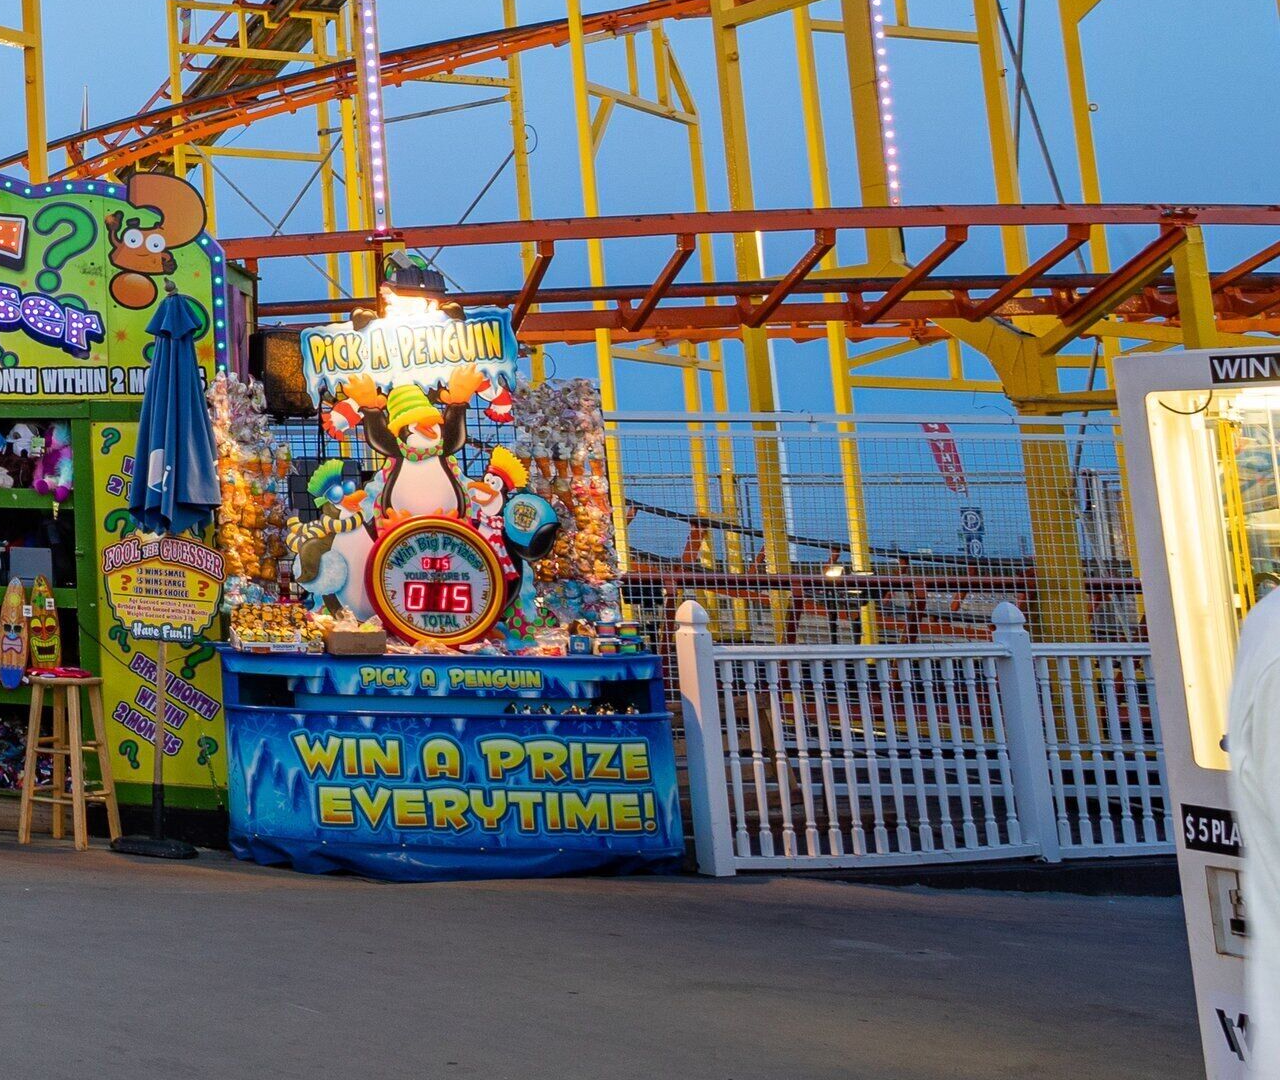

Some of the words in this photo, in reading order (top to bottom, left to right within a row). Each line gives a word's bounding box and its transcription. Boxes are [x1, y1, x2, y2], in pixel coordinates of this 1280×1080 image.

[370, 328, 390, 370] A
[397, 319, 503, 368] PENGUIN
[41, 367, 108, 395] WITHIN
[111, 367, 127, 395] 2
[107, 475, 125, 496] 2
[104, 539, 140, 571] FOOL
[142, 541, 159, 558] THE
[160, 538, 224, 580] GUESSER
[391, 544, 417, 570] Win
[415, 537, 440, 552] Big
[442, 536, 483, 571] Prizes
[164, 569, 186, 578] SMALL
[164, 579, 186, 587] LARGE
[404, 571, 428, 580] YOUR
[460, 572, 471, 580] IS
[164, 589, 189, 597] CHOICE
[132, 621, 159, 636] Have
[162, 623, 192, 639] Fun!!
[421, 613, 460, 628] TOTAL
[359, 666, 409, 689] PICK
[419, 668, 437, 688] A
[448, 667, 542, 690] PENGUIN
[167, 677, 221, 721] MONTH
[112, 701, 130, 722] 2
[293, 733, 402, 778] WIN
[421, 737, 461, 779] A
[478, 737, 652, 782] PRIZE
[318, 786, 659, 833] EVERYTIME!
[1211, 819, 1248, 848] PLA
